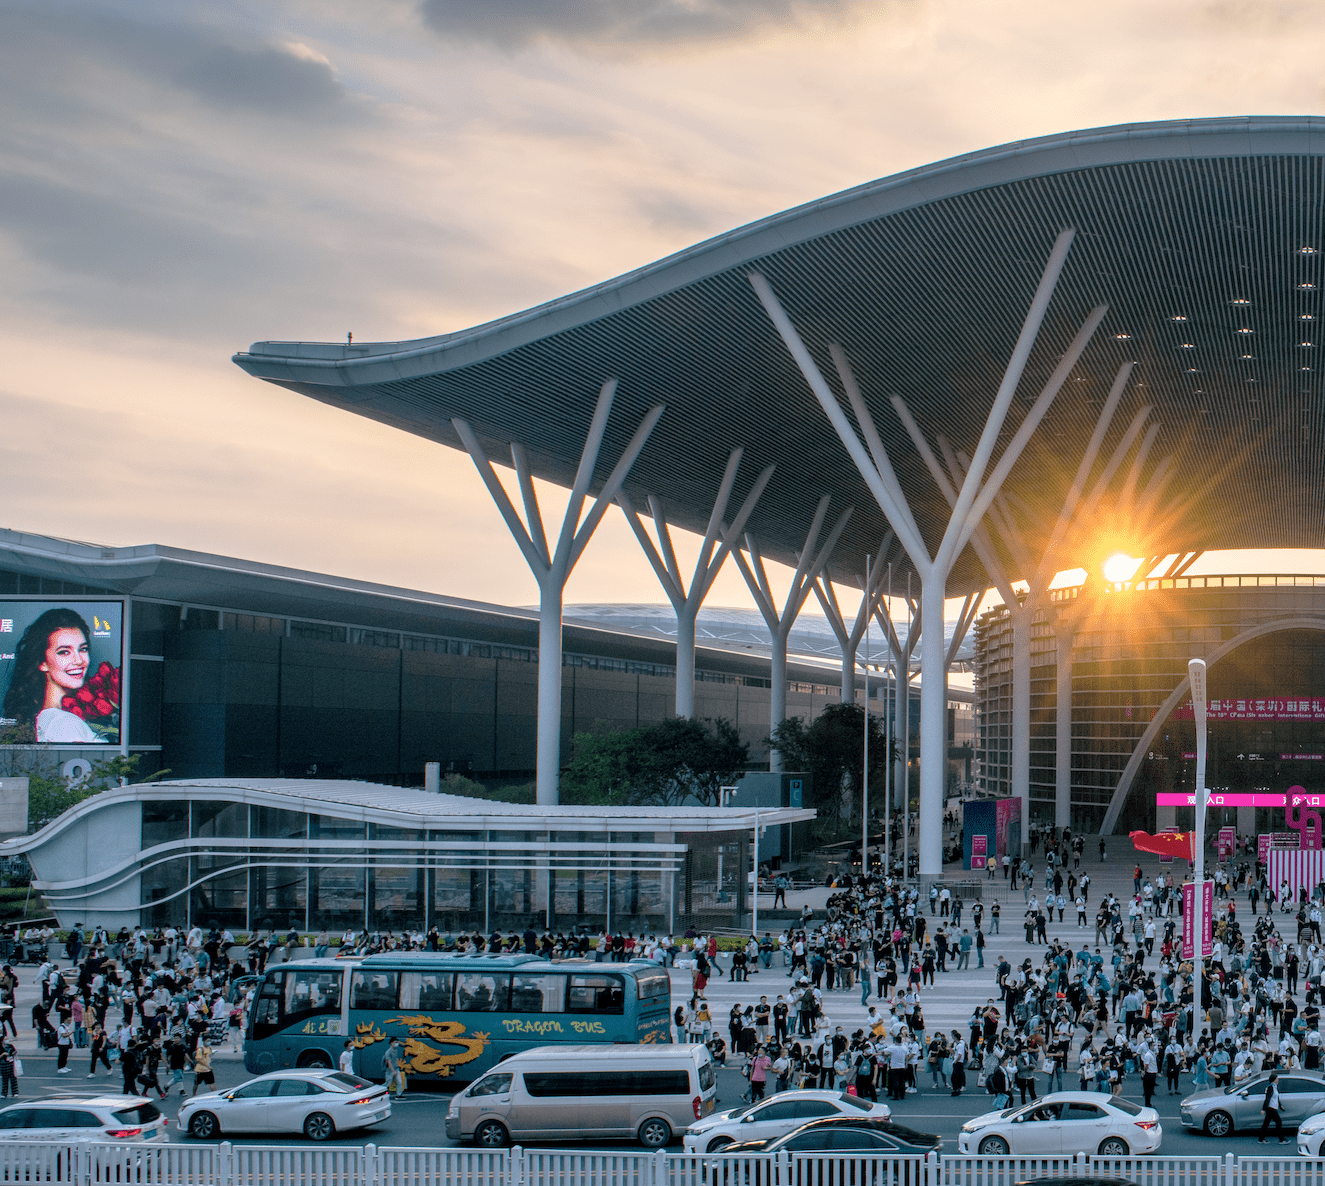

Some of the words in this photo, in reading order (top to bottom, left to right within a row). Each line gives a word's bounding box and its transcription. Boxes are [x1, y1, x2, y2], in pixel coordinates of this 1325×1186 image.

[1187, 795, 1225, 805] 观入口
[502, 1019, 564, 1036] DRAGON
[570, 1020, 606, 1034] BUS
